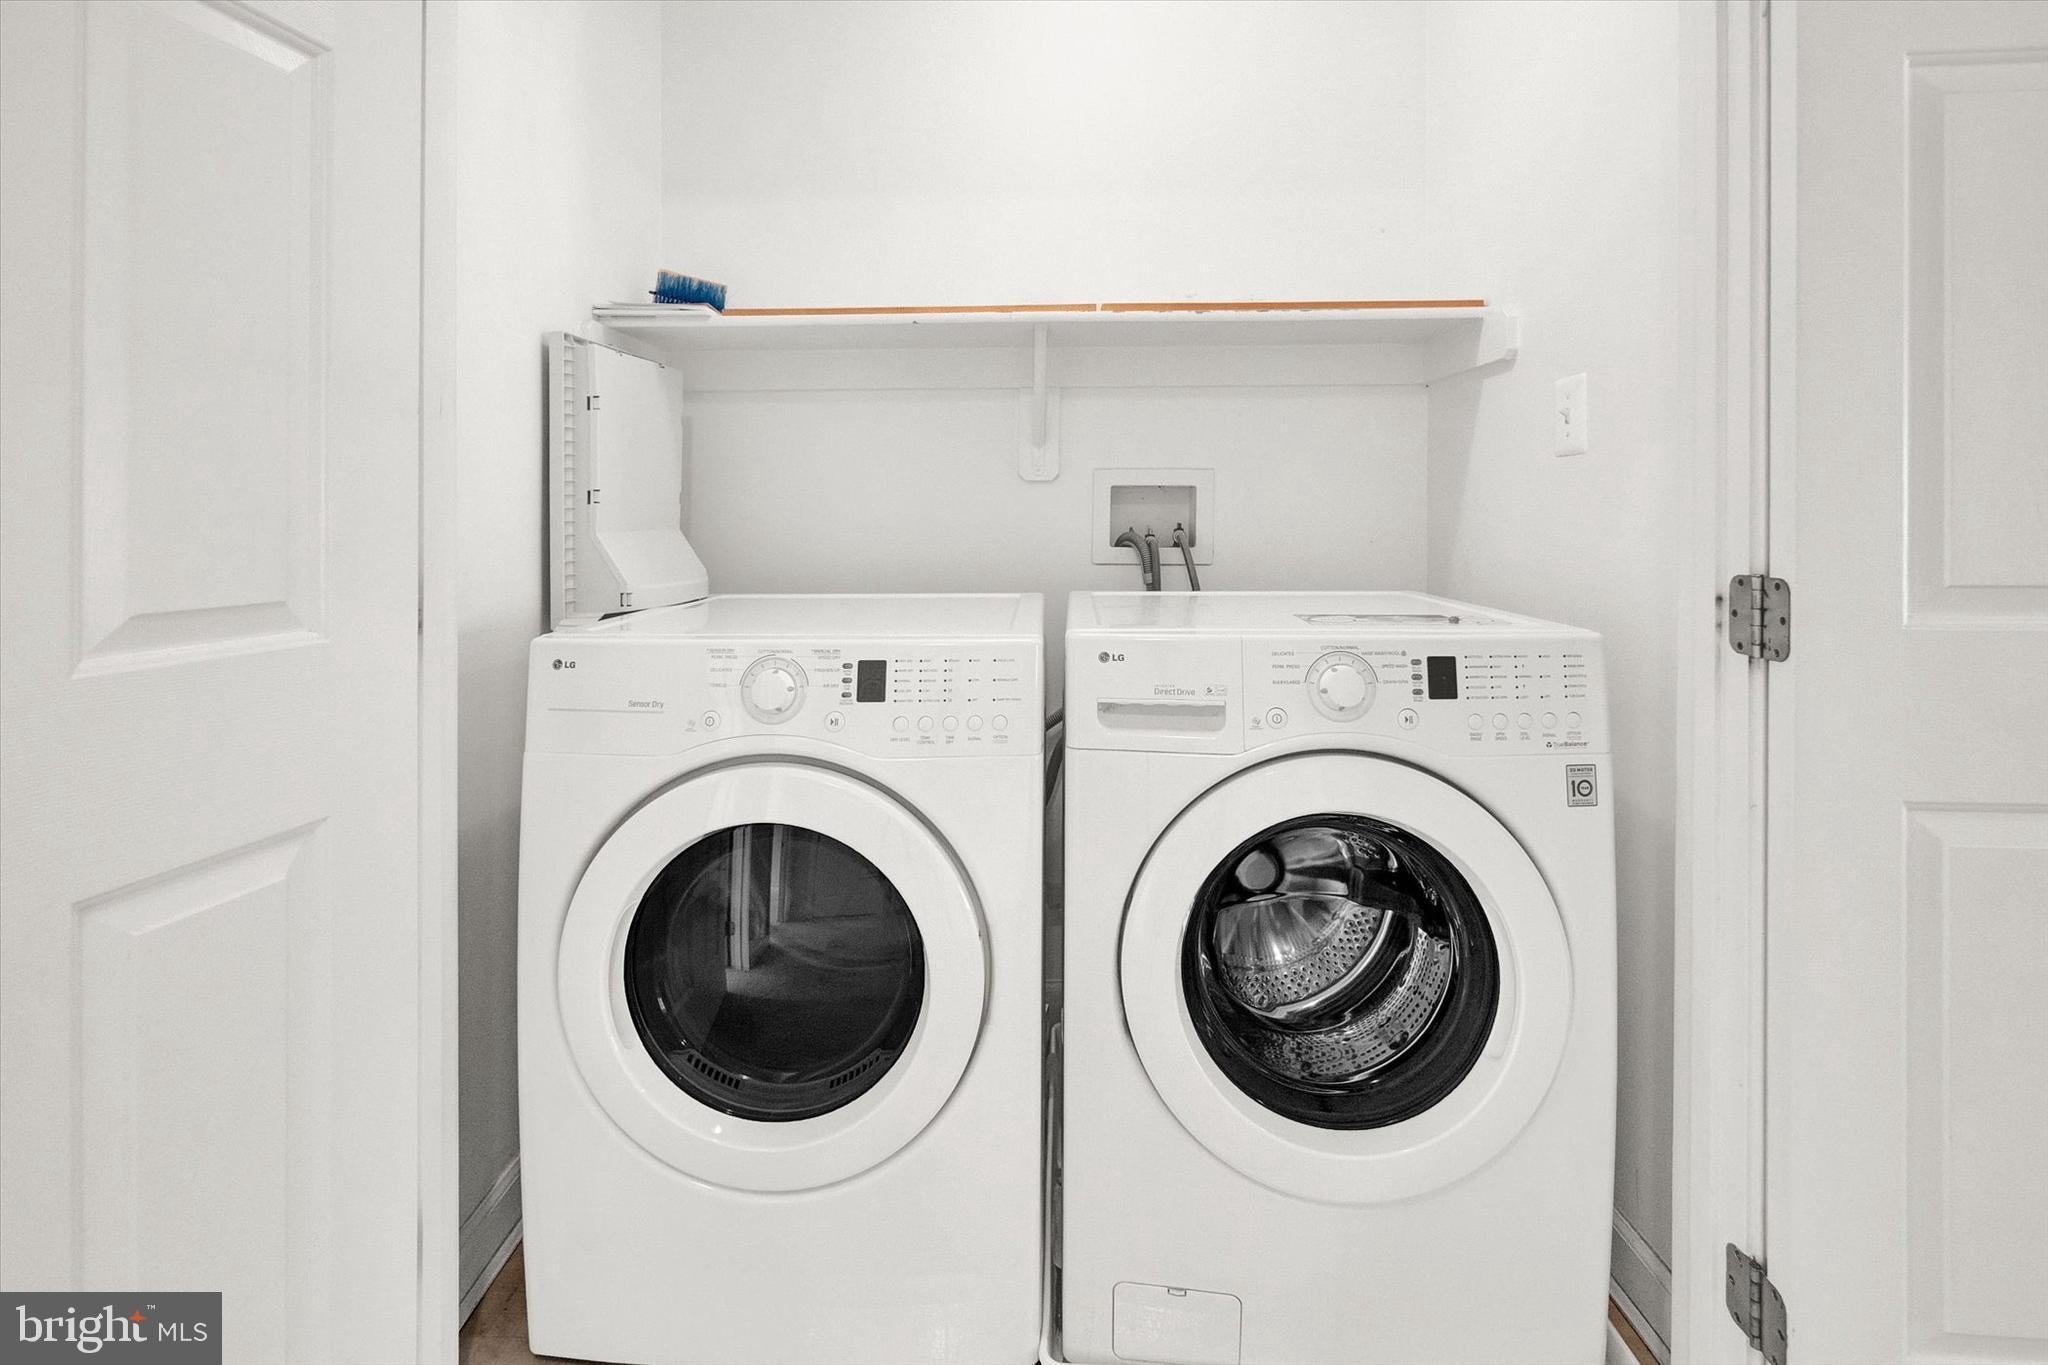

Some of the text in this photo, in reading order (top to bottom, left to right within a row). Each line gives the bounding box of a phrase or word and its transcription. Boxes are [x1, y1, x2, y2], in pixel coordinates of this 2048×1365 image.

[1112, 654, 1125, 662] LG
[564, 661, 576, 669] LG
[1154, 687, 1176, 696] Direct
[1176, 688, 1196, 696] Drive
[627, 700, 664, 709] Sensor Dry
[1570, 779, 1594, 798] 10
